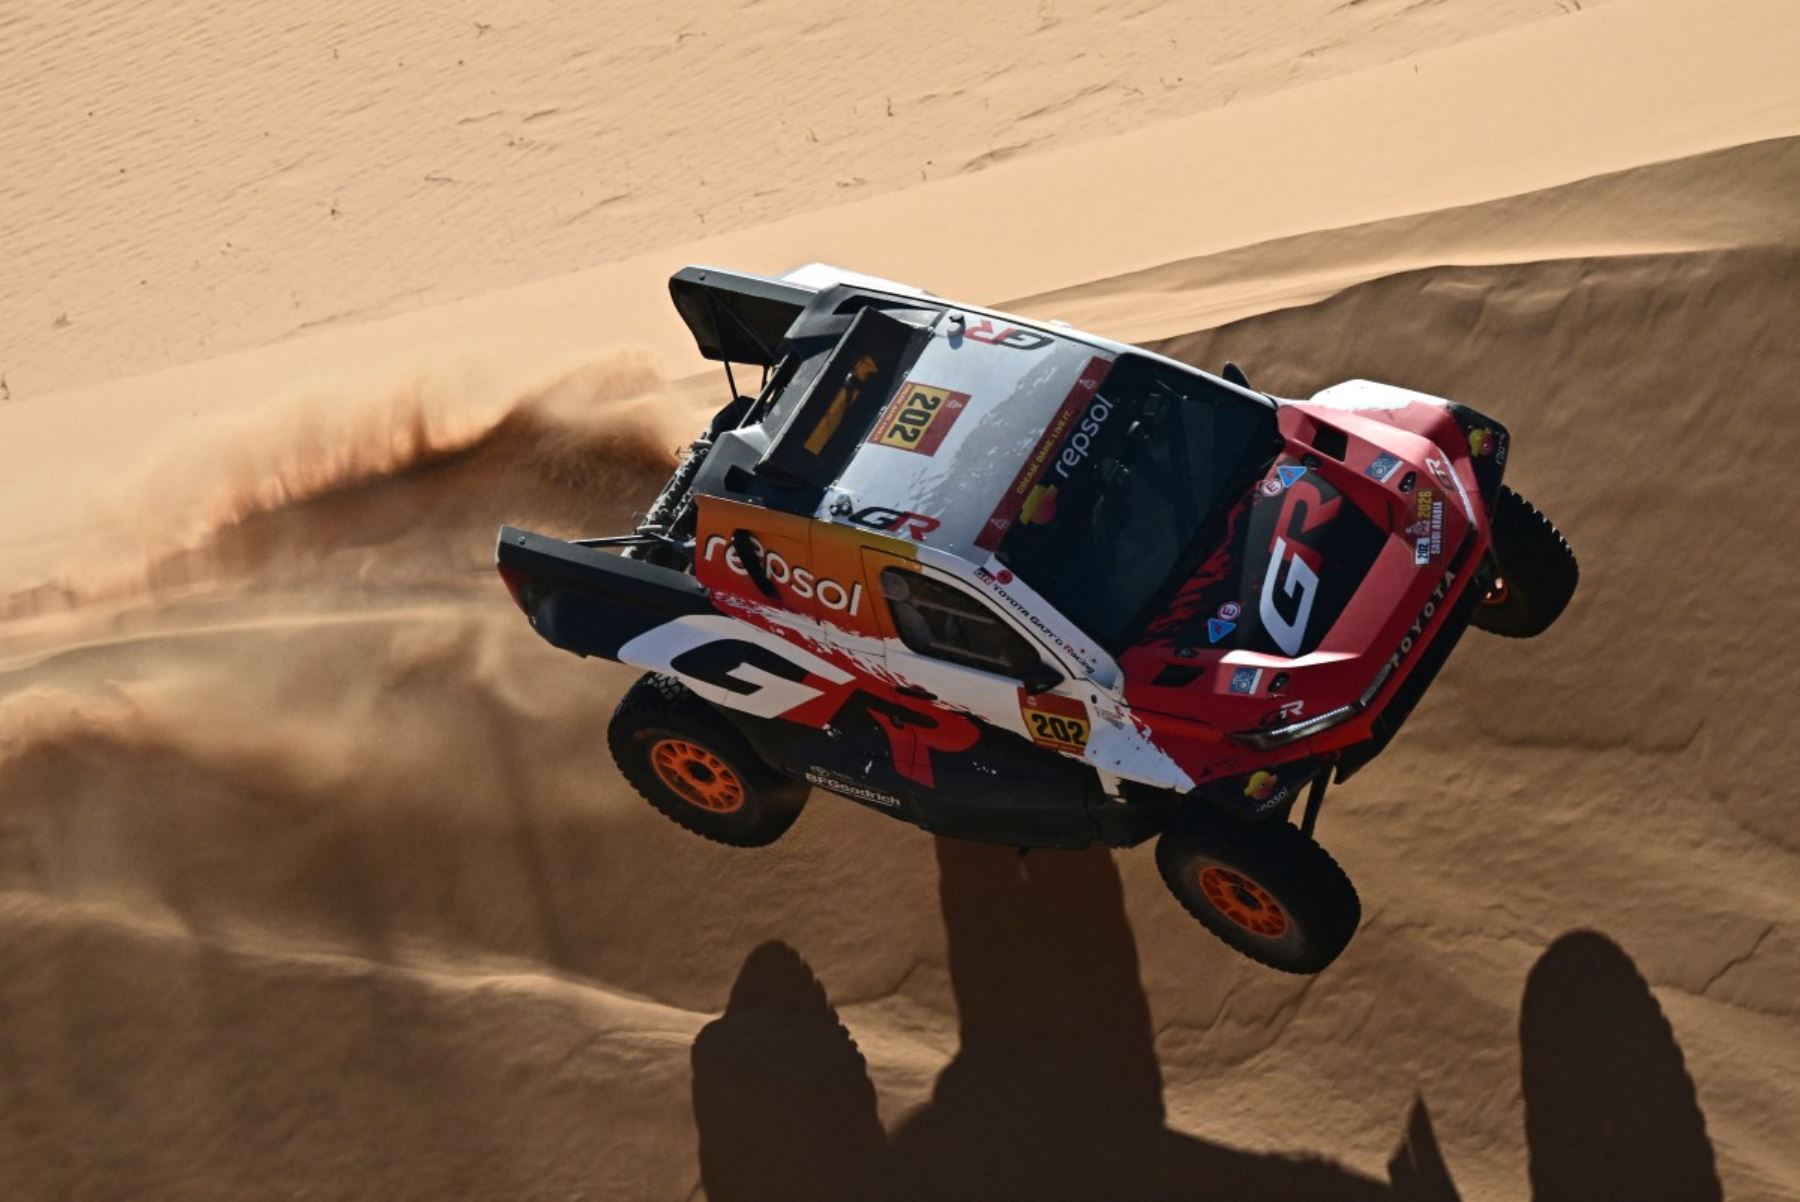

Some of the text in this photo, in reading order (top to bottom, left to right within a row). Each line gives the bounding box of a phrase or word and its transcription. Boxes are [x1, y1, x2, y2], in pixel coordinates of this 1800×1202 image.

[964, 319, 1055, 350] GR
[887, 392, 941, 443] 202
[1055, 394, 1114, 478] repsol
[849, 507, 941, 541] GR
[1260, 481, 1344, 657] GR
[993, 583, 1095, 675] TOYOTA GAZO Racing
[1391, 571, 1456, 668] TOYOTA
[617, 615, 982, 789] GR
[1031, 713, 1087, 747] 202
